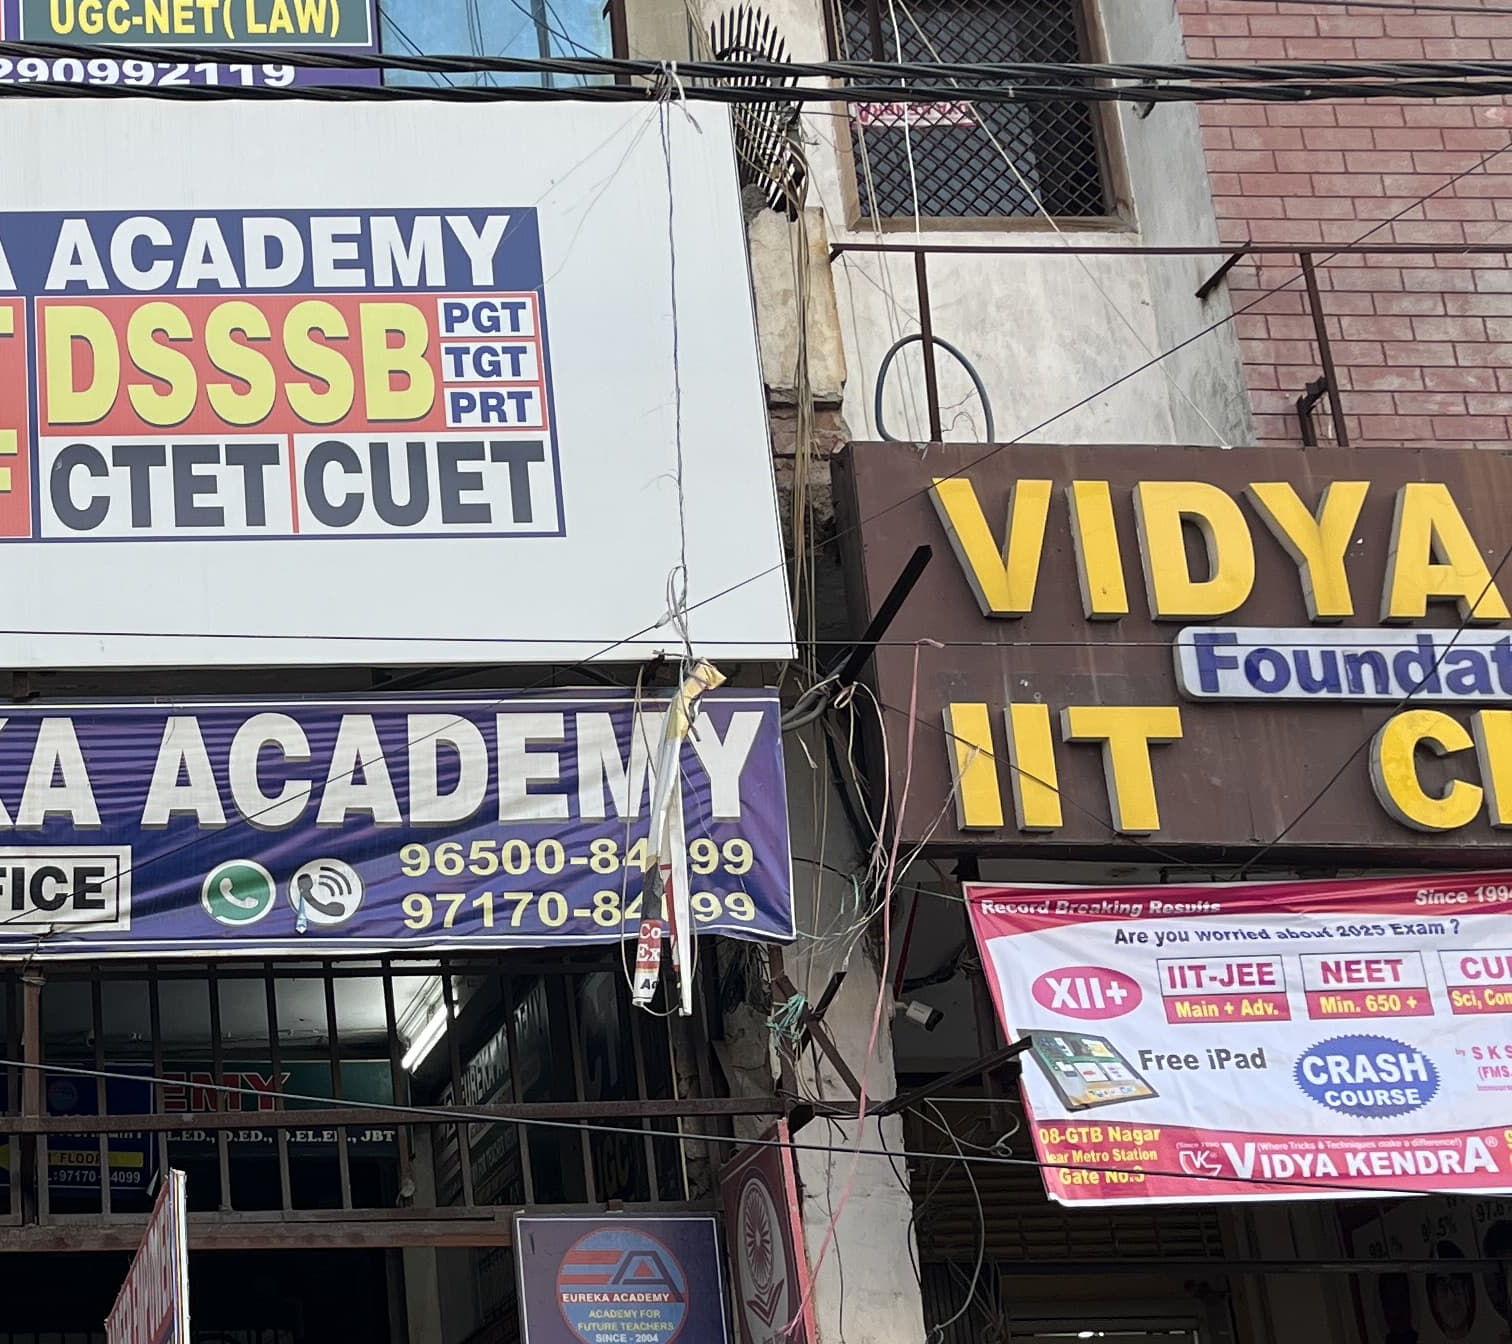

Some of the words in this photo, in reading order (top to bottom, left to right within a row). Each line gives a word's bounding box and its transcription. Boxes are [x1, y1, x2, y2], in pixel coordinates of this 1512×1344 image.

[45, 214, 510, 291] ACADEMY
[443, 302, 528, 336] PGT
[45, 300, 436, 427] DSSSB
[444, 346, 526, 379] TGT
[448, 390, 532, 425] PRT
[48, 442, 281, 532] CTET
[302, 437, 546, 529] CUET
[929, 478, 1512, 623] VIDYA
[140, 711, 764, 829] ACADEMY
[942, 703, 1183, 835] IIT
[982, 900, 1050, 915] Record
[1055, 900, 1143, 917] Breaking
[1149, 901, 1221, 916] Results
[1414, 888, 1469, 906] Since
[1114, 929, 1149, 945] Are
[1155, 928, 1190, 949] you
[1194, 928, 1271, 944] worried
[1277, 926, 1333, 941] about
[1338, 924, 1385, 939] 2025
[1390, 921, 1444, 937] Exam
[1168, 961, 1277, 989] IIT-JEE
[1321, 958, 1403, 984] NEET
[1047, 977, 1128, 1008] XII+
[1320, 997, 1360, 1013] Min.
[1366, 996, 1401, 1011] 650
[1176, 1001, 1219, 1018] Main
[1241, 999, 1279, 1017] Adv.
[1141, 1049, 1200, 1073] Free
[1207, 1047, 1267, 1071] iPad
[1302, 1054, 1429, 1085] CRASH
[1325, 1088, 1421, 1109] COURSE
[1108, 1127, 1161, 1145] Nagar
[1072, 1150, 1109, 1162] Metro
[1112, 1149, 1158, 1162] Station
[1222, 1142, 1338, 1179] VIDYA
[1347, 1137, 1499, 1176] KENDRA
[1059, 1168, 1100, 1185] Gate
